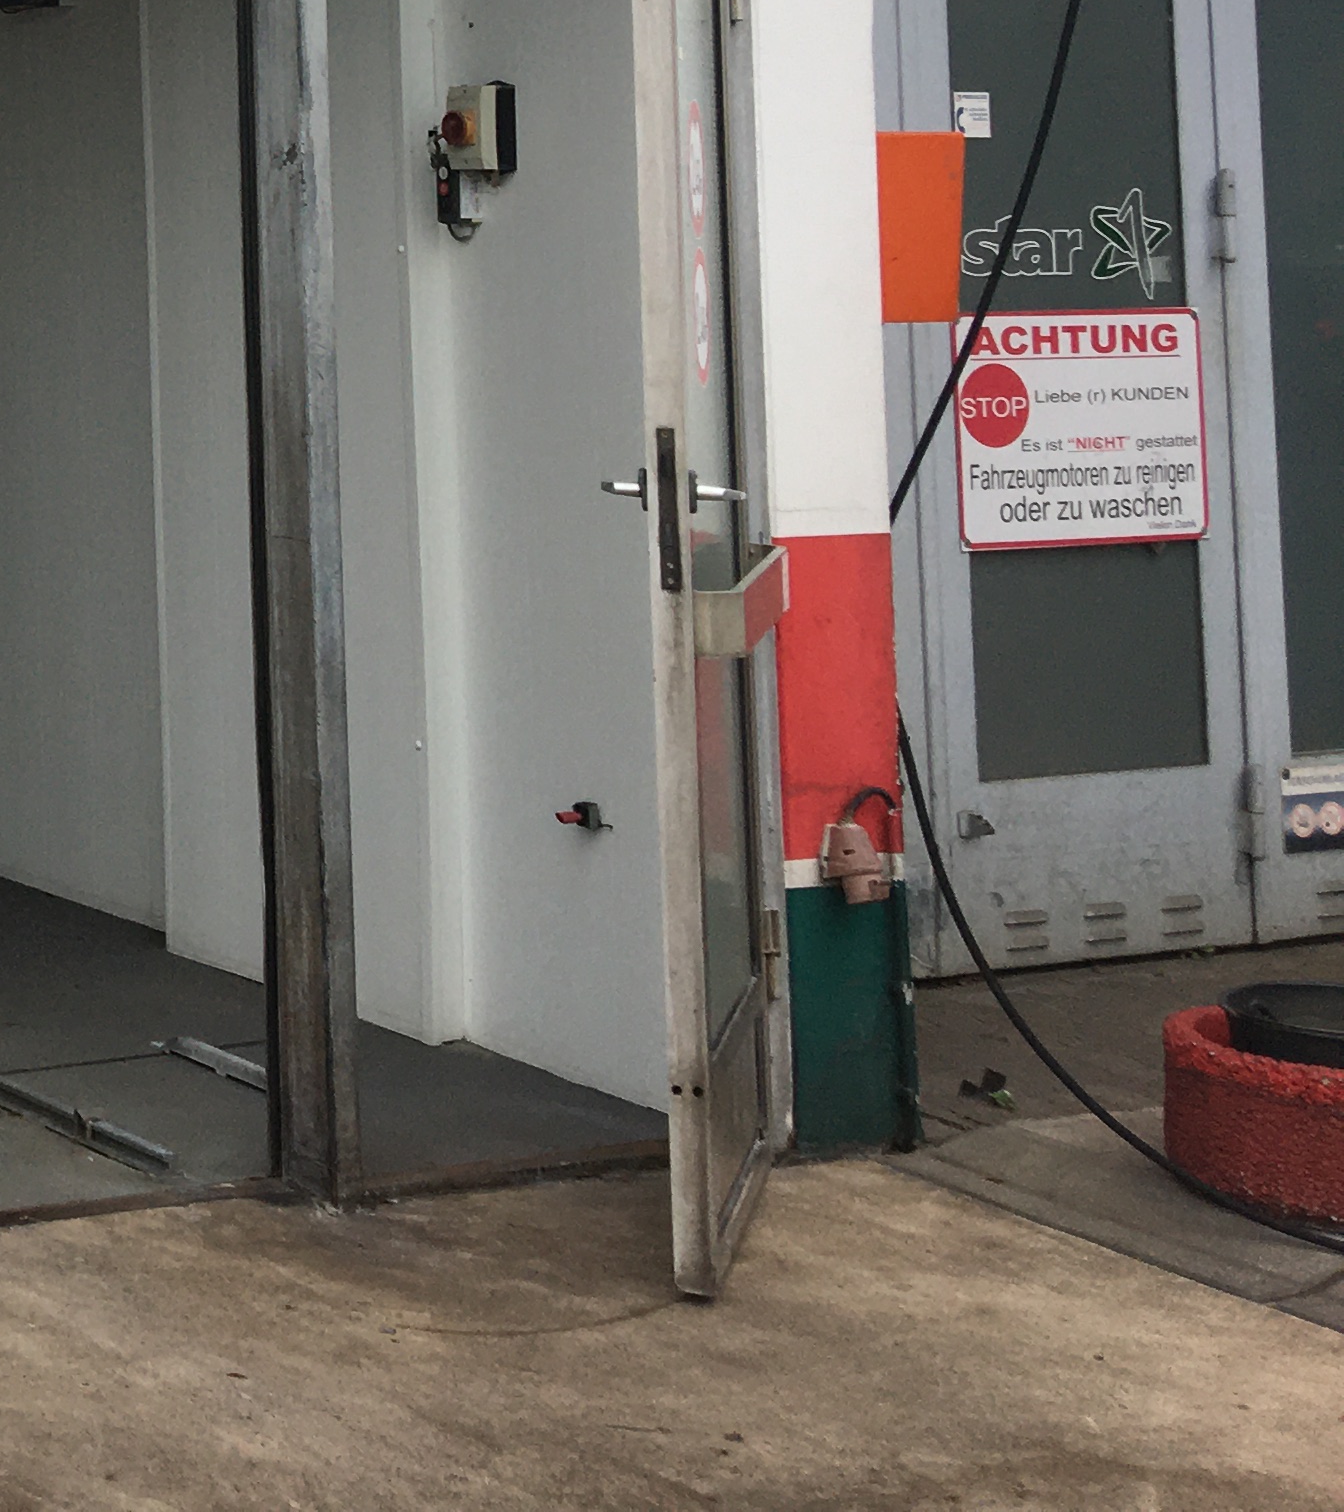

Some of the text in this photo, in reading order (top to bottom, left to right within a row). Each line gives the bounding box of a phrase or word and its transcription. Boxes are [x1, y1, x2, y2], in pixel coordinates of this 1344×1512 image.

[970, 323, 1179, 356] ACHTUNG
[961, 397, 1027, 419] STOP
[1034, 386, 1190, 406] Liebe (r) KUNDEN
[1021, 439, 1042, 452] Es
[1046, 439, 1063, 452] ist
[1135, 434, 1199, 451] gestattet
[969, 461, 1196, 495] Fahrzeugmotoren zu reinigen
[1000, 491, 1183, 523] oder zu waschen
